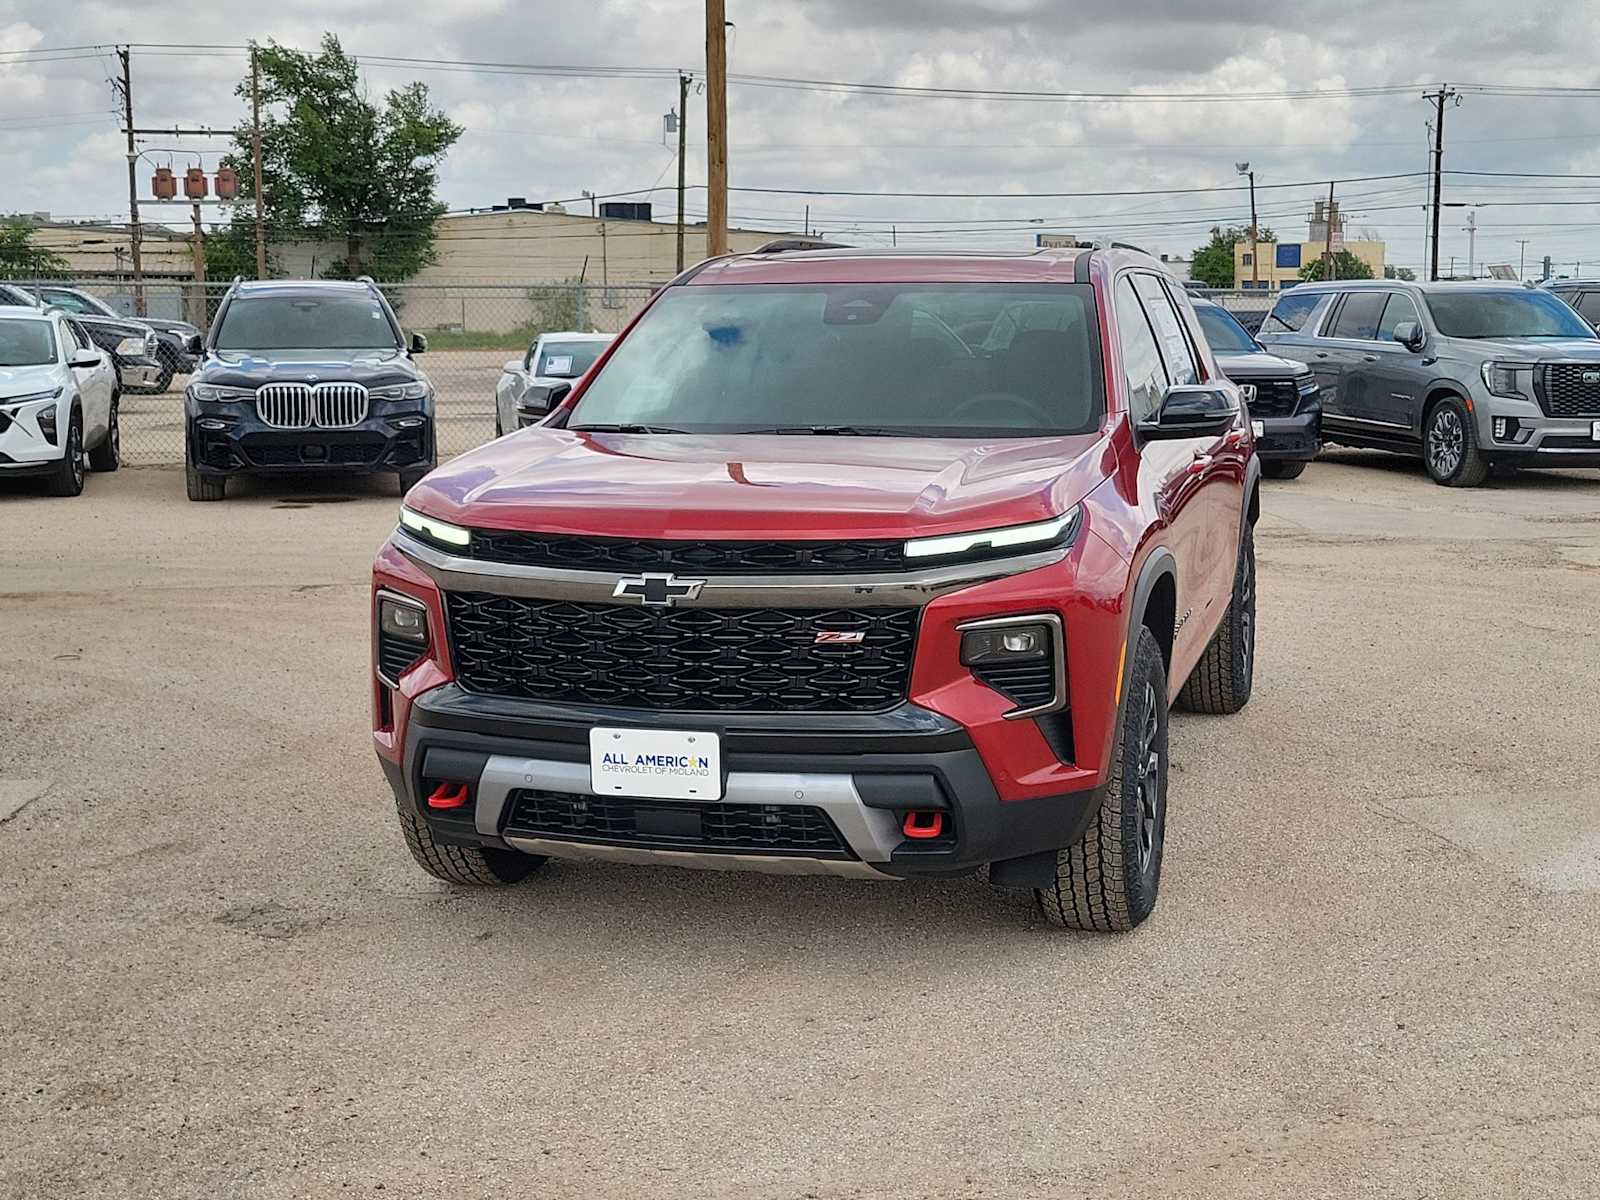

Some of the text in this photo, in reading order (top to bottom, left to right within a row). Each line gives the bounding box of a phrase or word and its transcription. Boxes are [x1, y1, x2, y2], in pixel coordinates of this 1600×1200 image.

[814, 632, 865, 643] Z71
[602, 753, 629, 765] ALL
[602, 765, 710, 777] CHEVROLET OF MIDLAND
